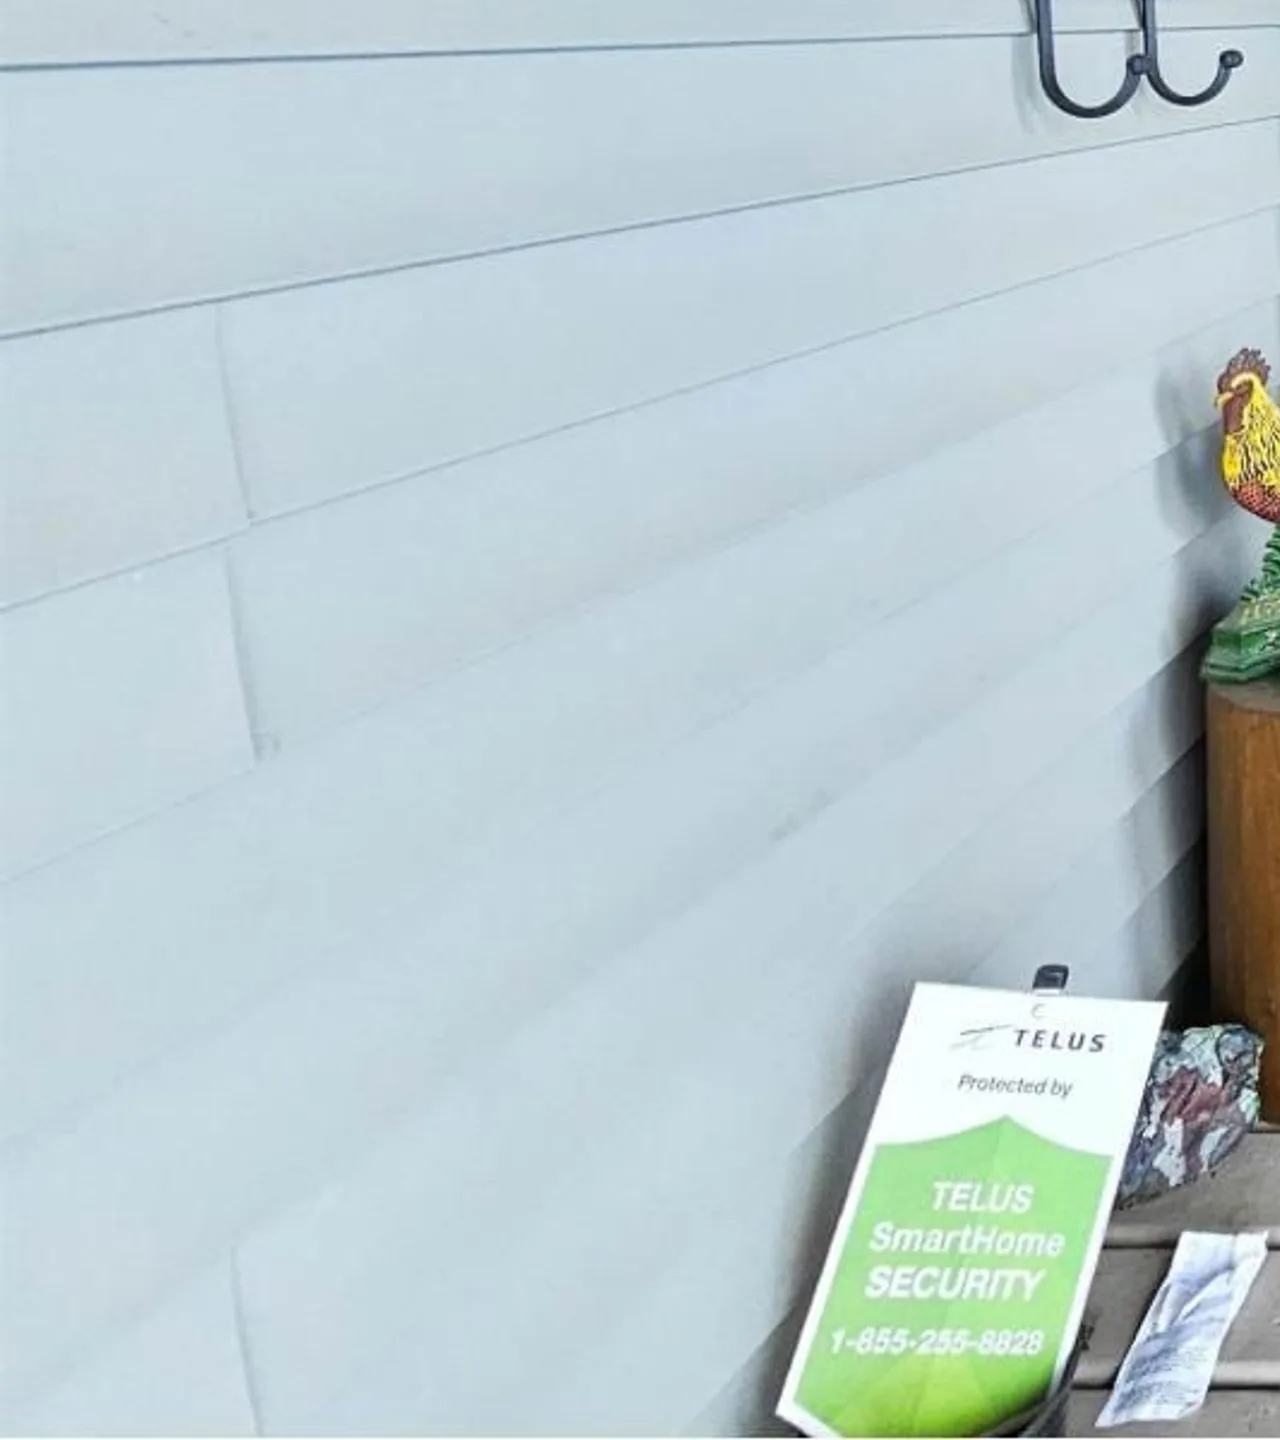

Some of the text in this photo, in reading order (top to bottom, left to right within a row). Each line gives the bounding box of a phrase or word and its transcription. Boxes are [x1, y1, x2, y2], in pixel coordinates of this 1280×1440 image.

[1014, 1029, 1107, 1053] TELUS
[957, 1073, 1073, 1102] Protected by
[932, 1181, 1035, 1214] TELUS
[869, 1221, 1066, 1257] SmartHome
[863, 1264, 1046, 1301] SECURITY
